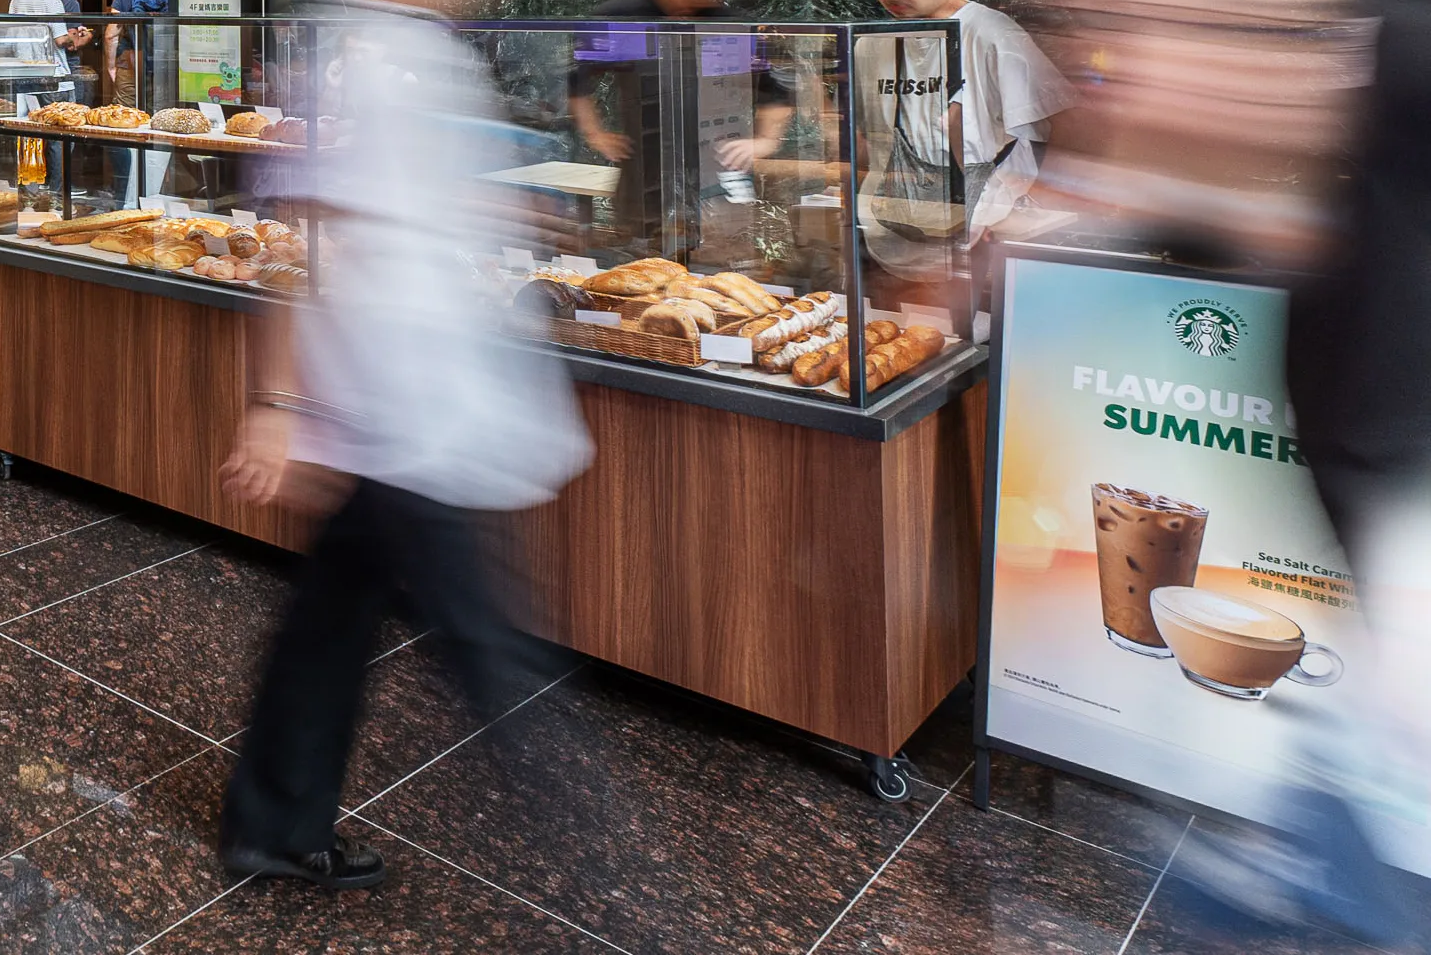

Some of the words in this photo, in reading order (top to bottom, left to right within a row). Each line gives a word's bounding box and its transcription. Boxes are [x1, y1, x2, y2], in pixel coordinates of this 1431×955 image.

[1167, 307, 1178, 318] WE
[1178, 298, 1222, 309] PROUDLY
[1224, 306, 1248, 328] SERVE
[1073, 365, 1274, 426] FLAVOUR
[1103, 403, 1310, 467] SUMMER
[1242, 561, 1298, 582] Flavored
[1301, 575, 1326, 589] Flat
[1258, 551, 1281, 565] Sea
[1284, 557, 1310, 572] Salt
